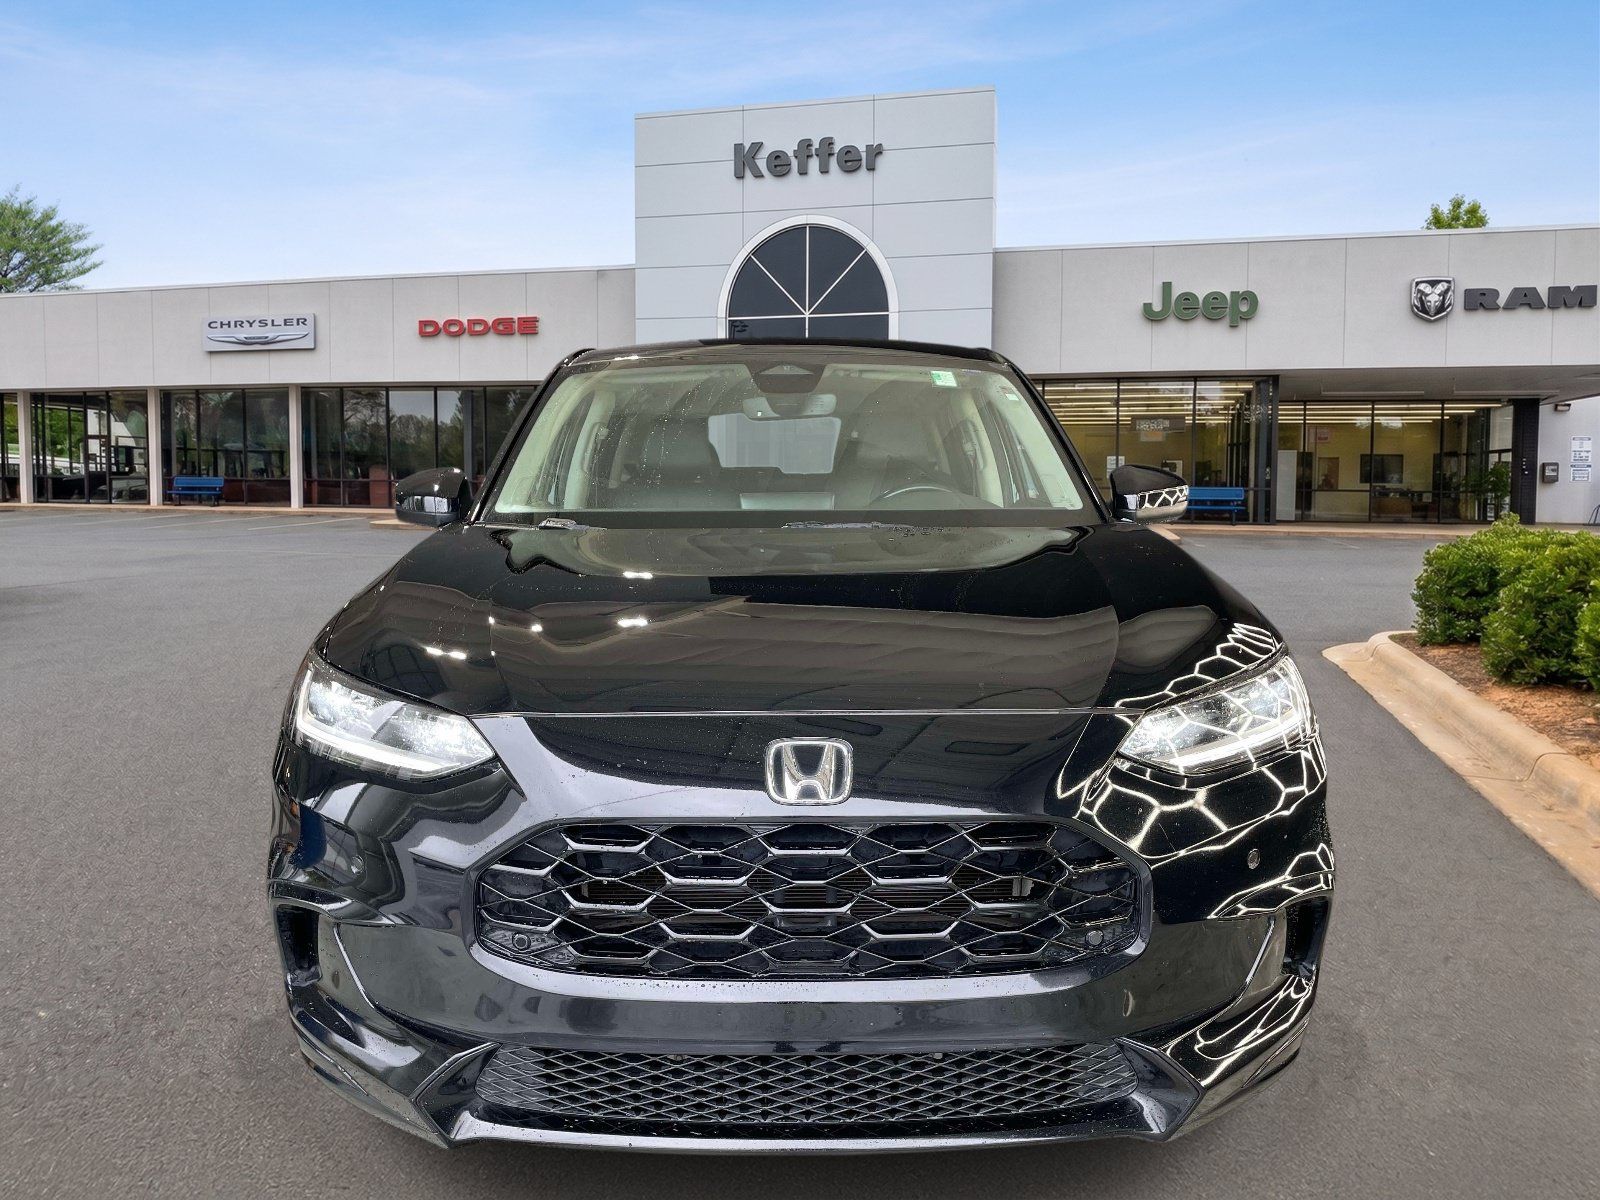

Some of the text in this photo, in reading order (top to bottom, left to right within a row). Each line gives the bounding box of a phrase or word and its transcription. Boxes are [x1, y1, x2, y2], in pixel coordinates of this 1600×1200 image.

[733, 137, 883, 178] Keffer
[1142, 281, 1259, 327] Jeep
[1463, 285, 1598, 310] RAM
[207, 317, 308, 330] CHRYSLER
[418, 316, 539, 337] DODGE
